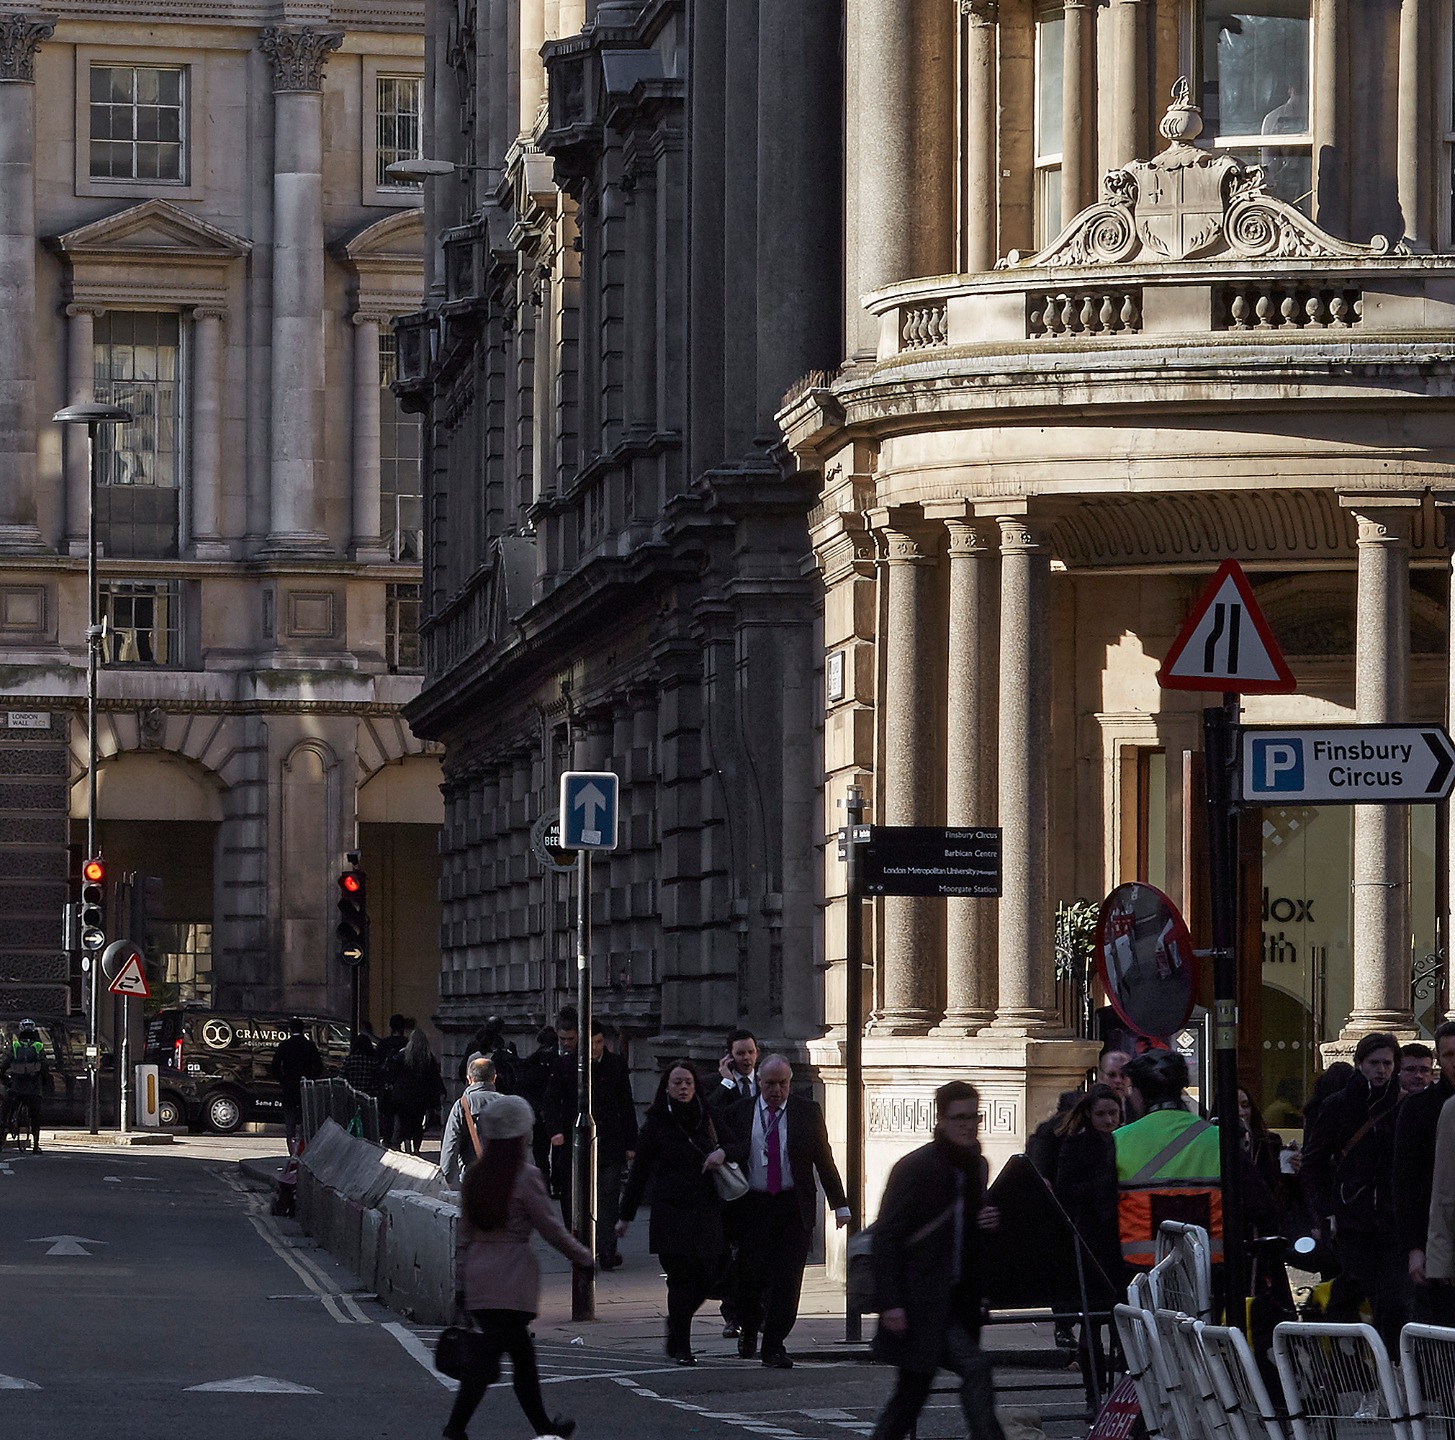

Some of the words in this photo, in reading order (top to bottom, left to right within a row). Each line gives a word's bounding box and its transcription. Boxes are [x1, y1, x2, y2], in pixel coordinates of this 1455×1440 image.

[1313, 740, 1412, 763] Finsbury
[1265, 744, 1297, 787] P
[1328, 766, 1404, 787] Circus
[945, 831, 974, 840] Finsbury
[975, 831, 998, 839] Circus
[944, 849, 973, 857] Barbican
[974, 850, 997, 858] Centre
[907, 867, 946, 875] Metropolitan
[946, 867, 976, 876] University
[939, 885, 973, 893] Moorgate
[973, 885, 997, 893] Station
[235, 1028, 311, 1041] CRAWFOS
[1094, 1411, 1137, 1439] RIGHT
